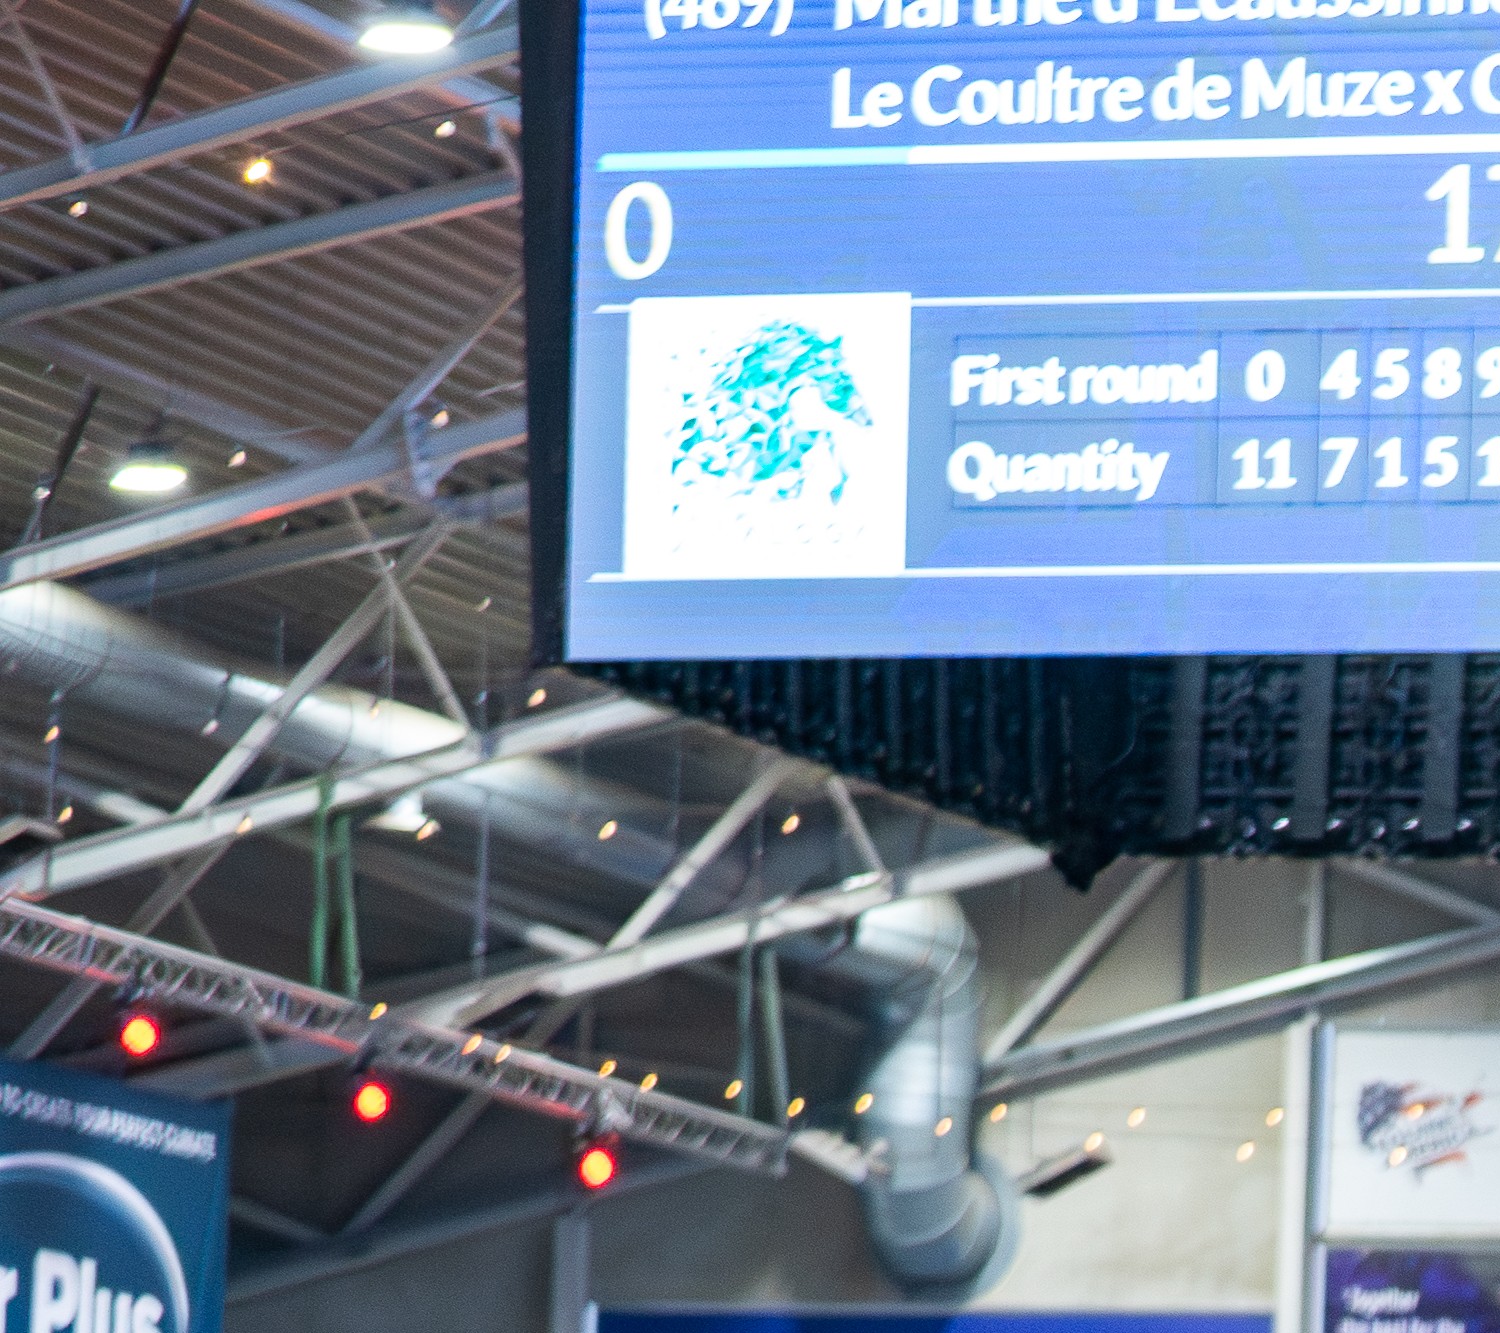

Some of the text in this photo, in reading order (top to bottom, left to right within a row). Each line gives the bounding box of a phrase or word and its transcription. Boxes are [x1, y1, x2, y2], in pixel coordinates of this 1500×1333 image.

[830, 67, 902, 129] Le
[912, 60, 1144, 125] Coultre
[1150, 56, 1232, 122] de
[1240, 54, 1414, 118] Muze
[1420, 66, 1465, 116] x
[603, 181, 674, 281] 0
[950, 354, 1063, 406] First
[1065, 350, 1220, 406] round
[1244, 349, 1286, 402] 0
[1319, 348, 1361, 400] 4
[1372, 347, 1411, 399] 5
[1422, 346, 1462, 399] 8
[946, 440, 1171, 502] Quantity
[1230, 437, 1298, 491] 11
[1320, 437, 1359, 489] 7
[1374, 436, 1409, 488] 1
[1422, 436, 1460, 488] 5
